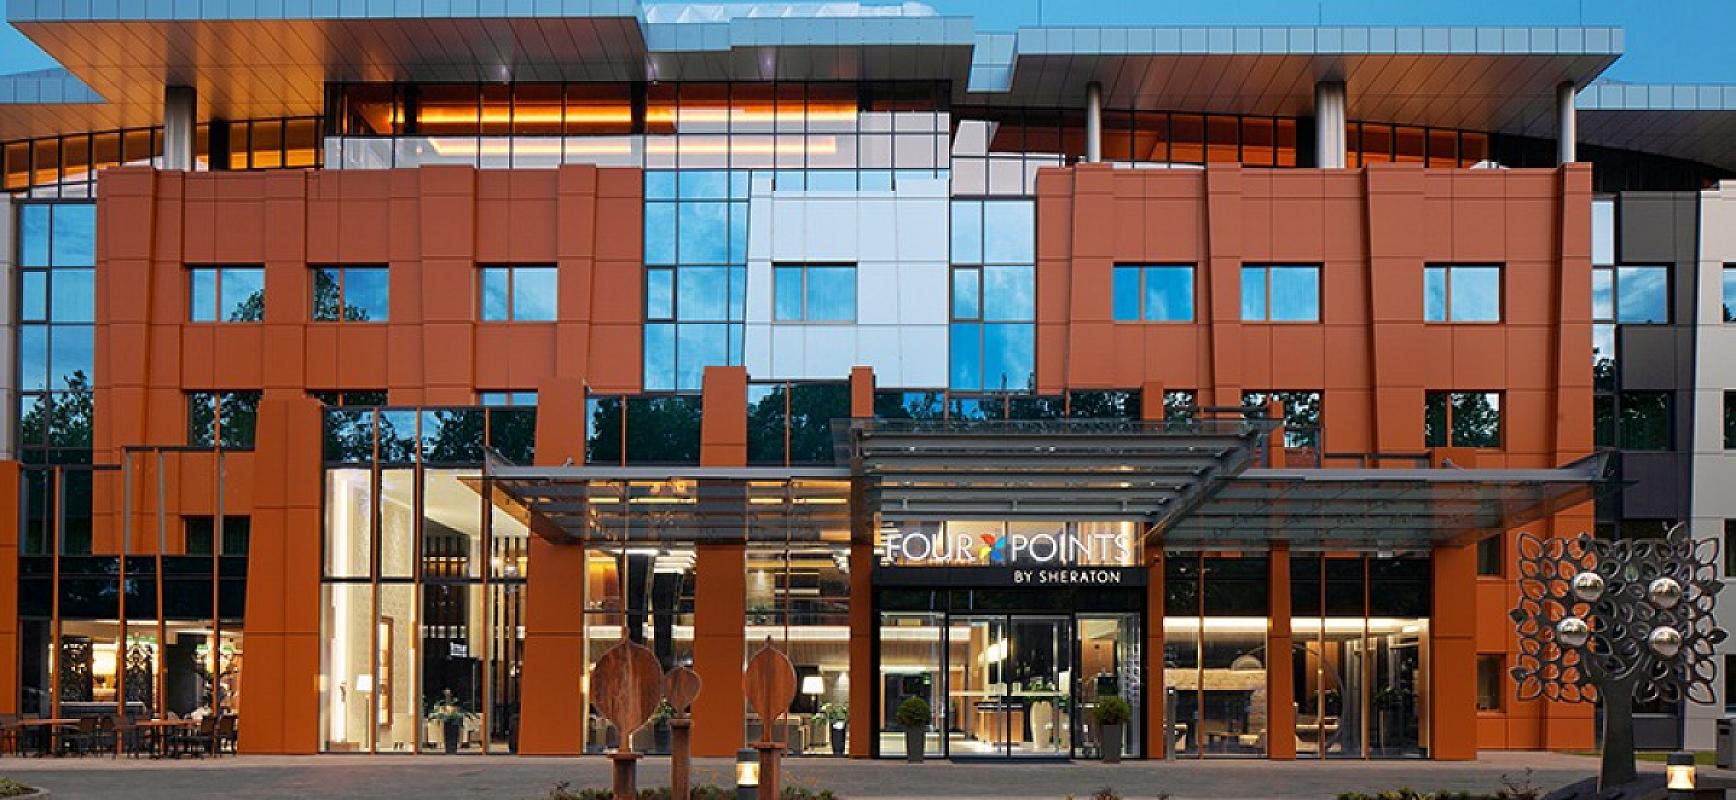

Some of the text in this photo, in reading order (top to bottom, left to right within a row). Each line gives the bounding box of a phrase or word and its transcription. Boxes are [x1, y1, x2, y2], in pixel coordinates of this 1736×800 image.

[886, 533, 1131, 562] FOUR POINTS
[1013, 569, 1121, 584] BY SHERATON
